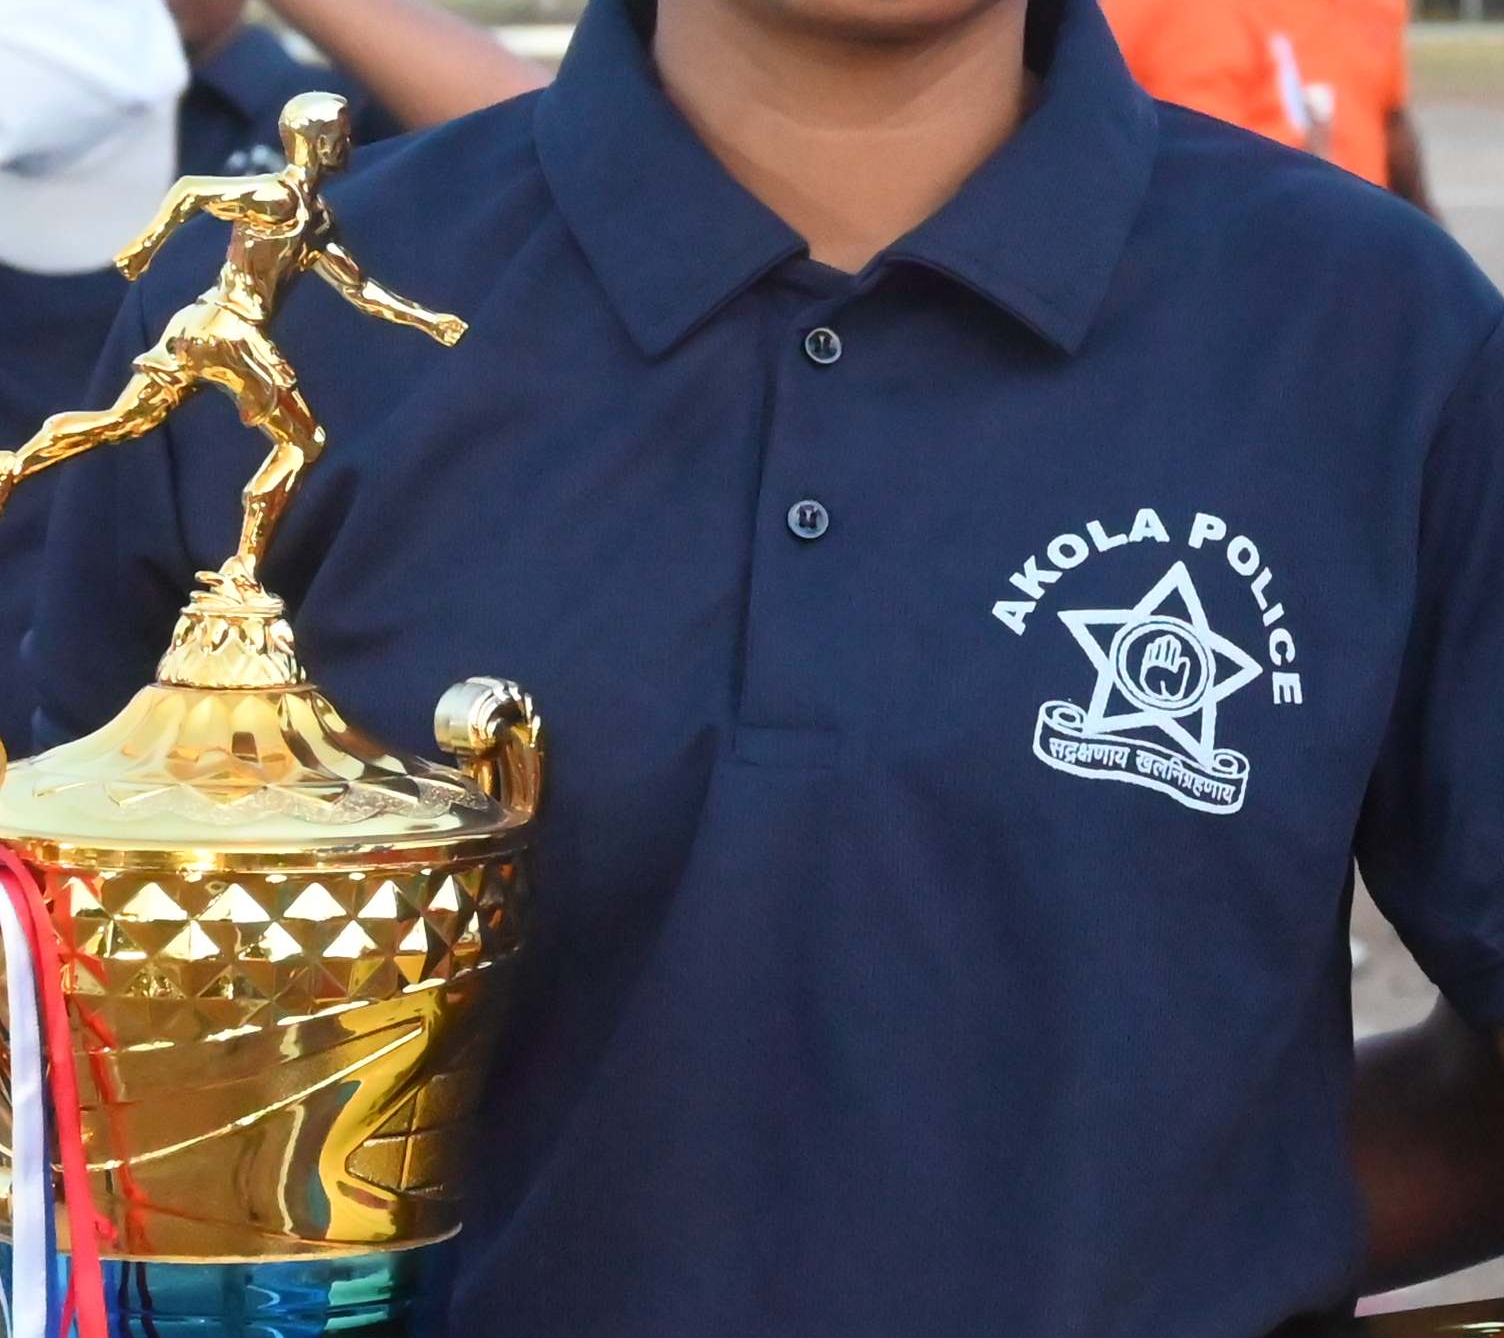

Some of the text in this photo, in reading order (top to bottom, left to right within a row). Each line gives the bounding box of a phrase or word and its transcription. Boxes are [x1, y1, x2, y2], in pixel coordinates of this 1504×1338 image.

[992, 508, 1303, 704] AKOLA POLICE
[1049, 737, 1237, 804] सद्रक्षणाय खलनिग्रहणाय
